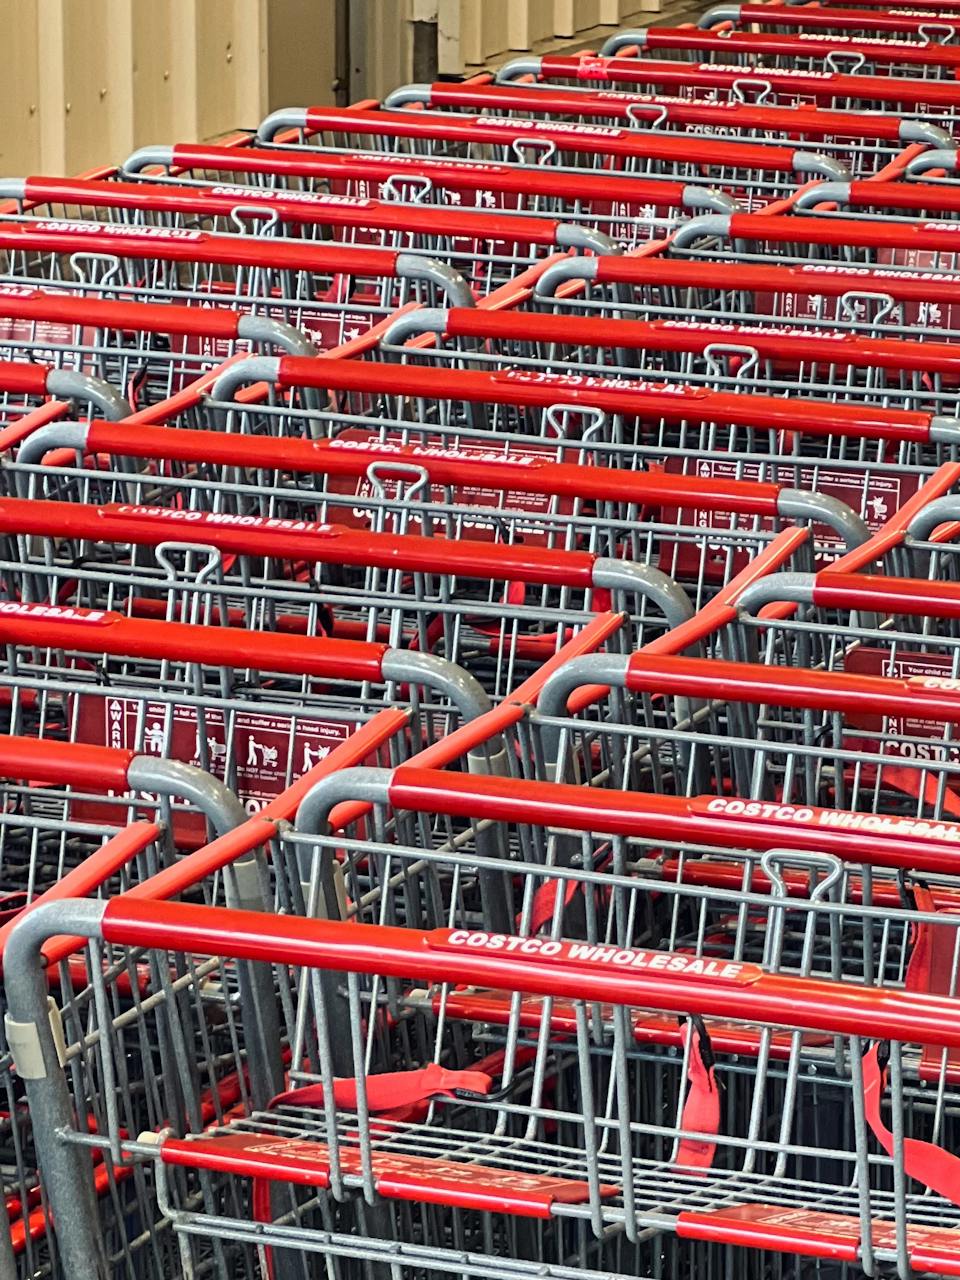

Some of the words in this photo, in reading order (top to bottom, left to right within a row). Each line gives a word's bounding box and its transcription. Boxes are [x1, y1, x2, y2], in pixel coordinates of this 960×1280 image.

[799, 33, 849, 42] COSTCO
[852, 36, 928, 48] WHOLESALE
[699, 63, 751, 73] COSTCO
[754, 66, 832, 78] WHOLESALE
[598, 92, 652, 102] COSTCO
[655, 96, 736, 107] WHOLESALE
[476, 118, 534, 128] COSTCO
[536, 122, 622, 136] WHOLESALE
[212, 186, 276, 198] COSTCO
[276, 191, 370, 206] WHOLESALE
[104, 225, 202, 240] WHOLESALE
[802, 265, 870, 276] COSTCO
[662, 320, 735, 332] COSTCO
[738, 325, 846, 340] WHOLESALE
[706, 798, 814, 823] COSTCO
[448, 930, 562, 956] COSTCO
[568, 944, 744, 978] WHOLESALE
